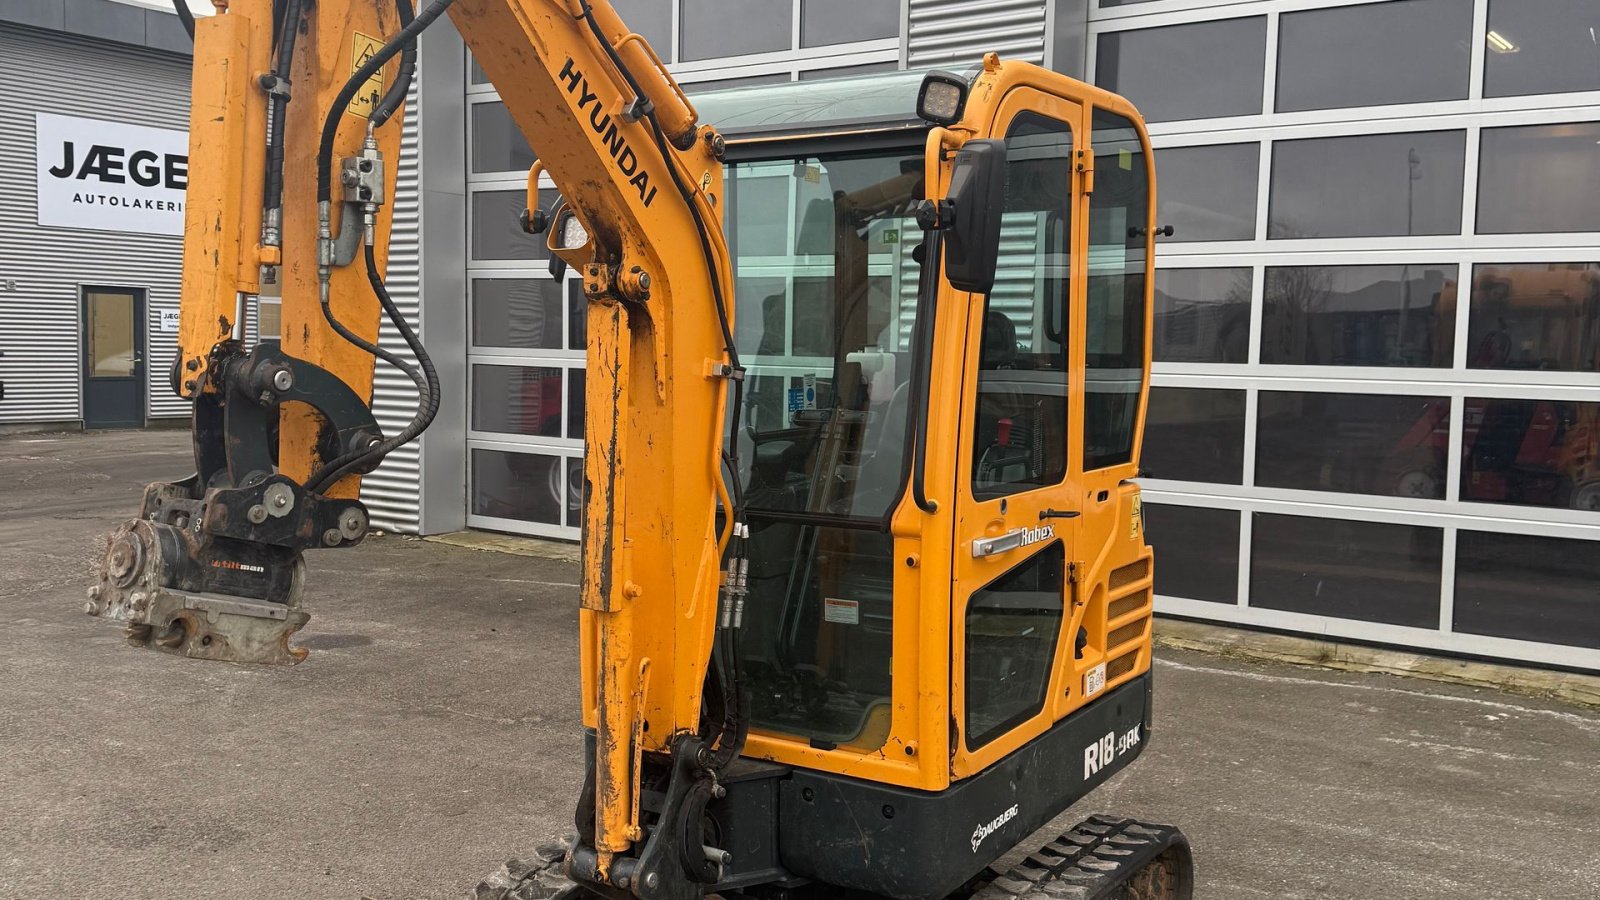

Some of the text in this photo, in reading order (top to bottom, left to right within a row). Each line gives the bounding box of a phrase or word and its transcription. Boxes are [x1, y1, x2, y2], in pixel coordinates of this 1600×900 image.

[558, 57, 658, 208] HYUNDAI
[49, 141, 189, 190] JÆGE
[73, 193, 182, 212] AUTOLAKERI
[1020, 524, 1055, 546] Robex
